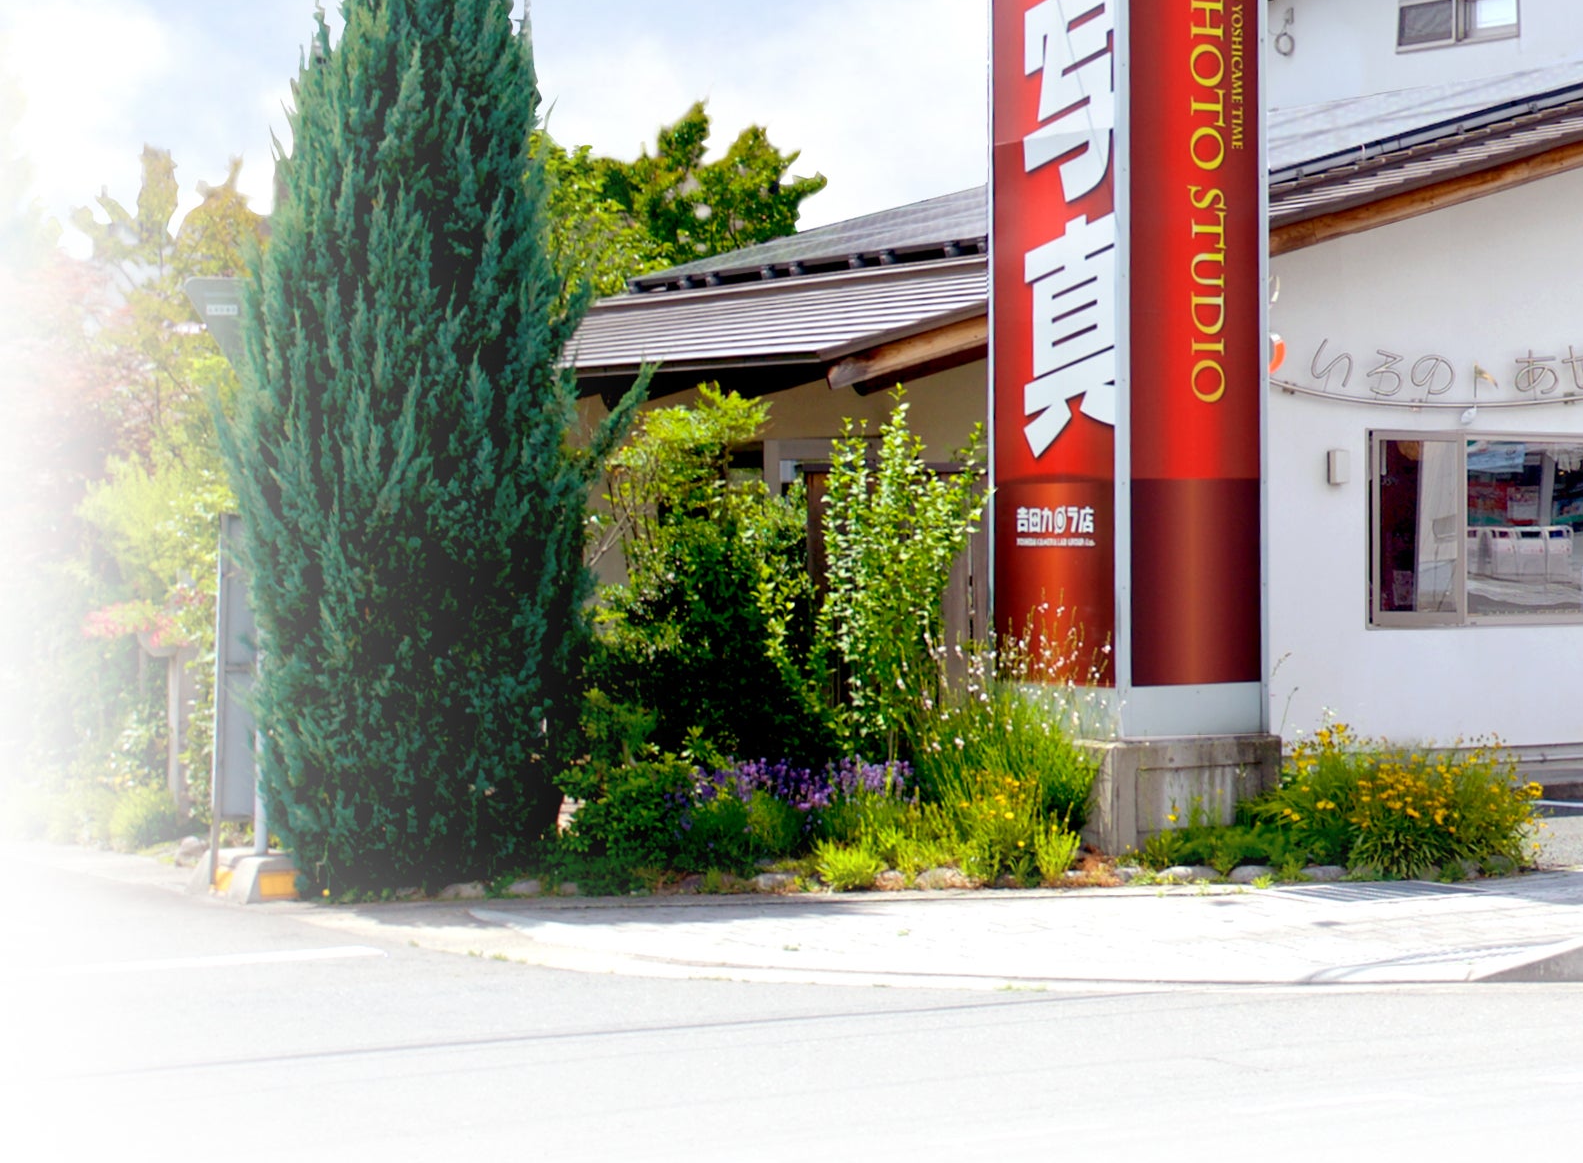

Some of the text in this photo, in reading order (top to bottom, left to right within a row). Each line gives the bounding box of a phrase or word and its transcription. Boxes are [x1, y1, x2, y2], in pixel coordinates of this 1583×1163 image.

[1231, 3, 1244, 104] YOSHICAME
[1231, 106, 1244, 150] TIME
[1187, 186, 1227, 404] STUDIO
[1310, 338, 1456, 397] いろの
